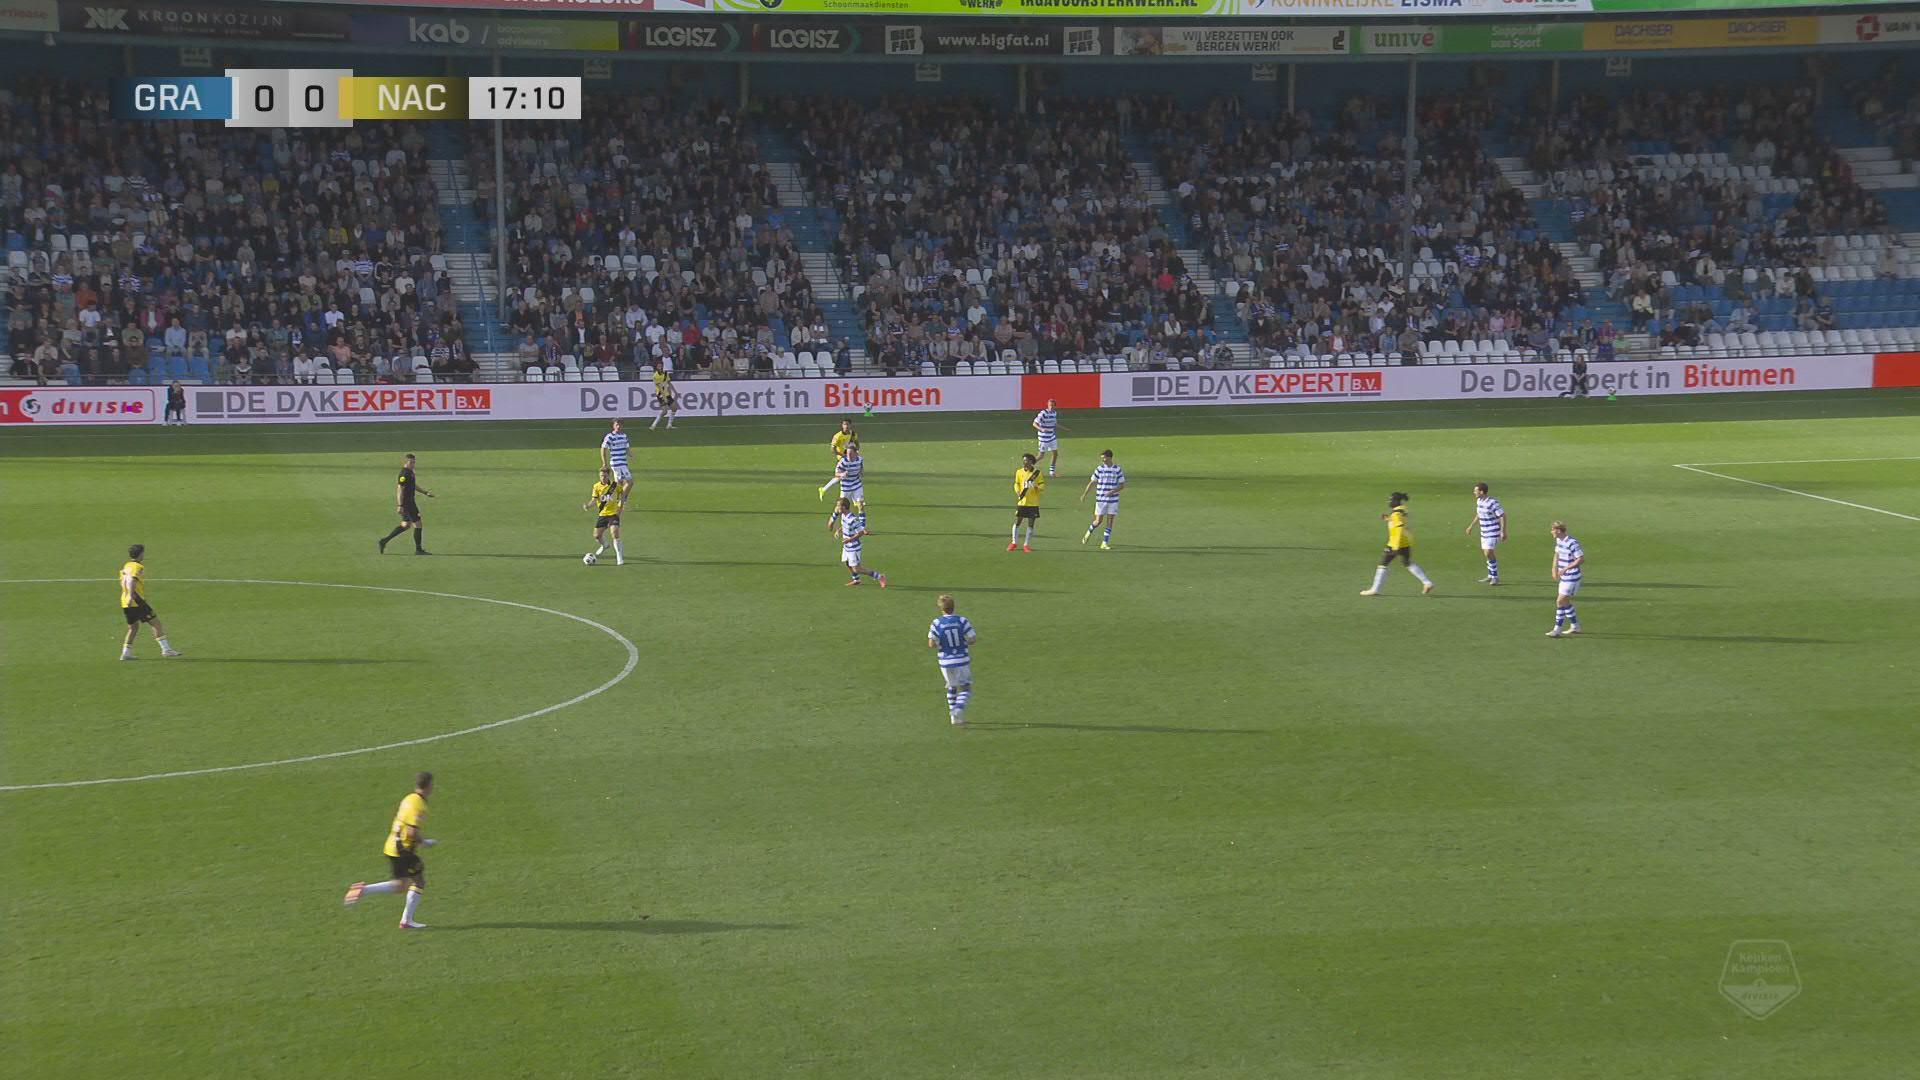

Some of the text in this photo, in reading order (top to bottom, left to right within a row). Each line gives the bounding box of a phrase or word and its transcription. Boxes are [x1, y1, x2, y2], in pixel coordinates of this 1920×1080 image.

[409, 16, 470, 44] kab
[645, 26, 717, 48] LOGISZ
[770, 28, 840, 49] LOGISZ
[1204, 31, 1267, 41] VERZETTEN
[1271, 31, 1294, 41] OOK
[937, 33, 1049, 50] www.bigfat.nl
[1196, 41, 1280, 52] BERGEN WERK!
[1157, 376, 1189, 396] DE
[1200, 372, 1348, 395] DAKEXPERT
[1460, 364, 1794, 393] De Dakepert in Bitumen
[51, 398, 144, 415] divisie
[226, 391, 265, 413] DE
[277, 389, 452, 413] DAKEXPERT
[579, 387, 618, 412] De
[784, 384, 810, 408] in
[824, 384, 941, 408] Bitumen
[944, 628, 960, 648] 11
